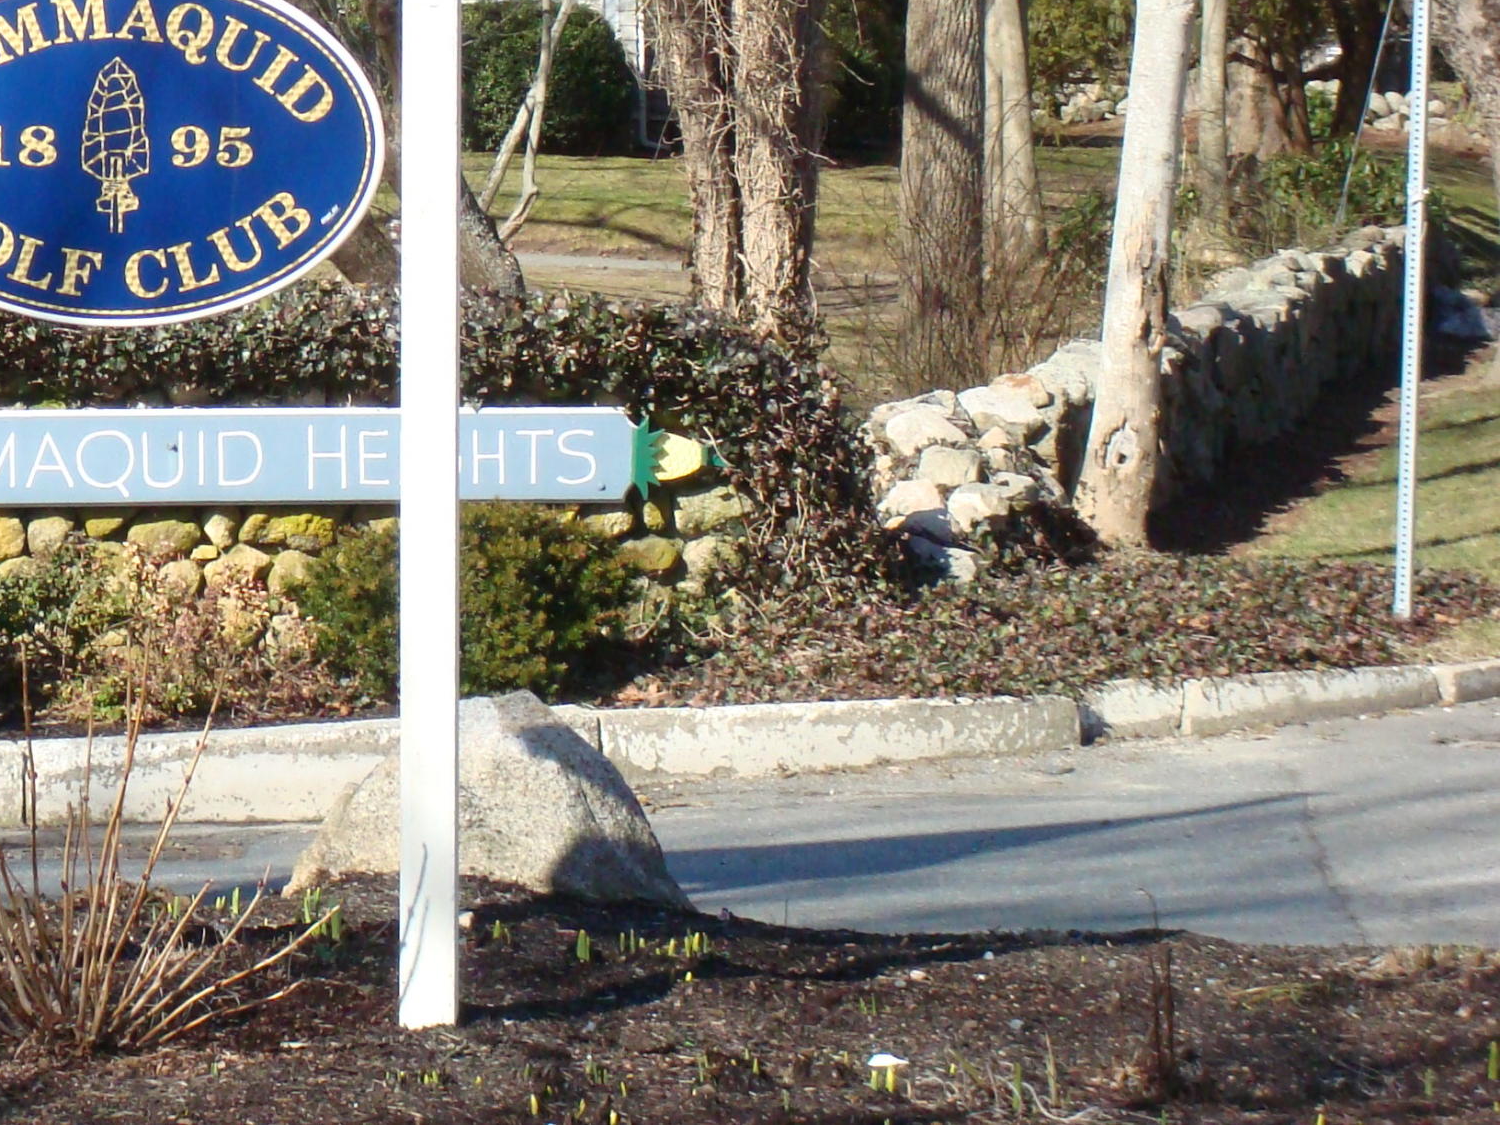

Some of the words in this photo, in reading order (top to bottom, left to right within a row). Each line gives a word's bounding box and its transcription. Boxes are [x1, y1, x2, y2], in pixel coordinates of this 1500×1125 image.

[170, 125, 254, 168] 95
[124, 190, 312, 299] CLUB
[307, 423, 597, 490] HEHTS
